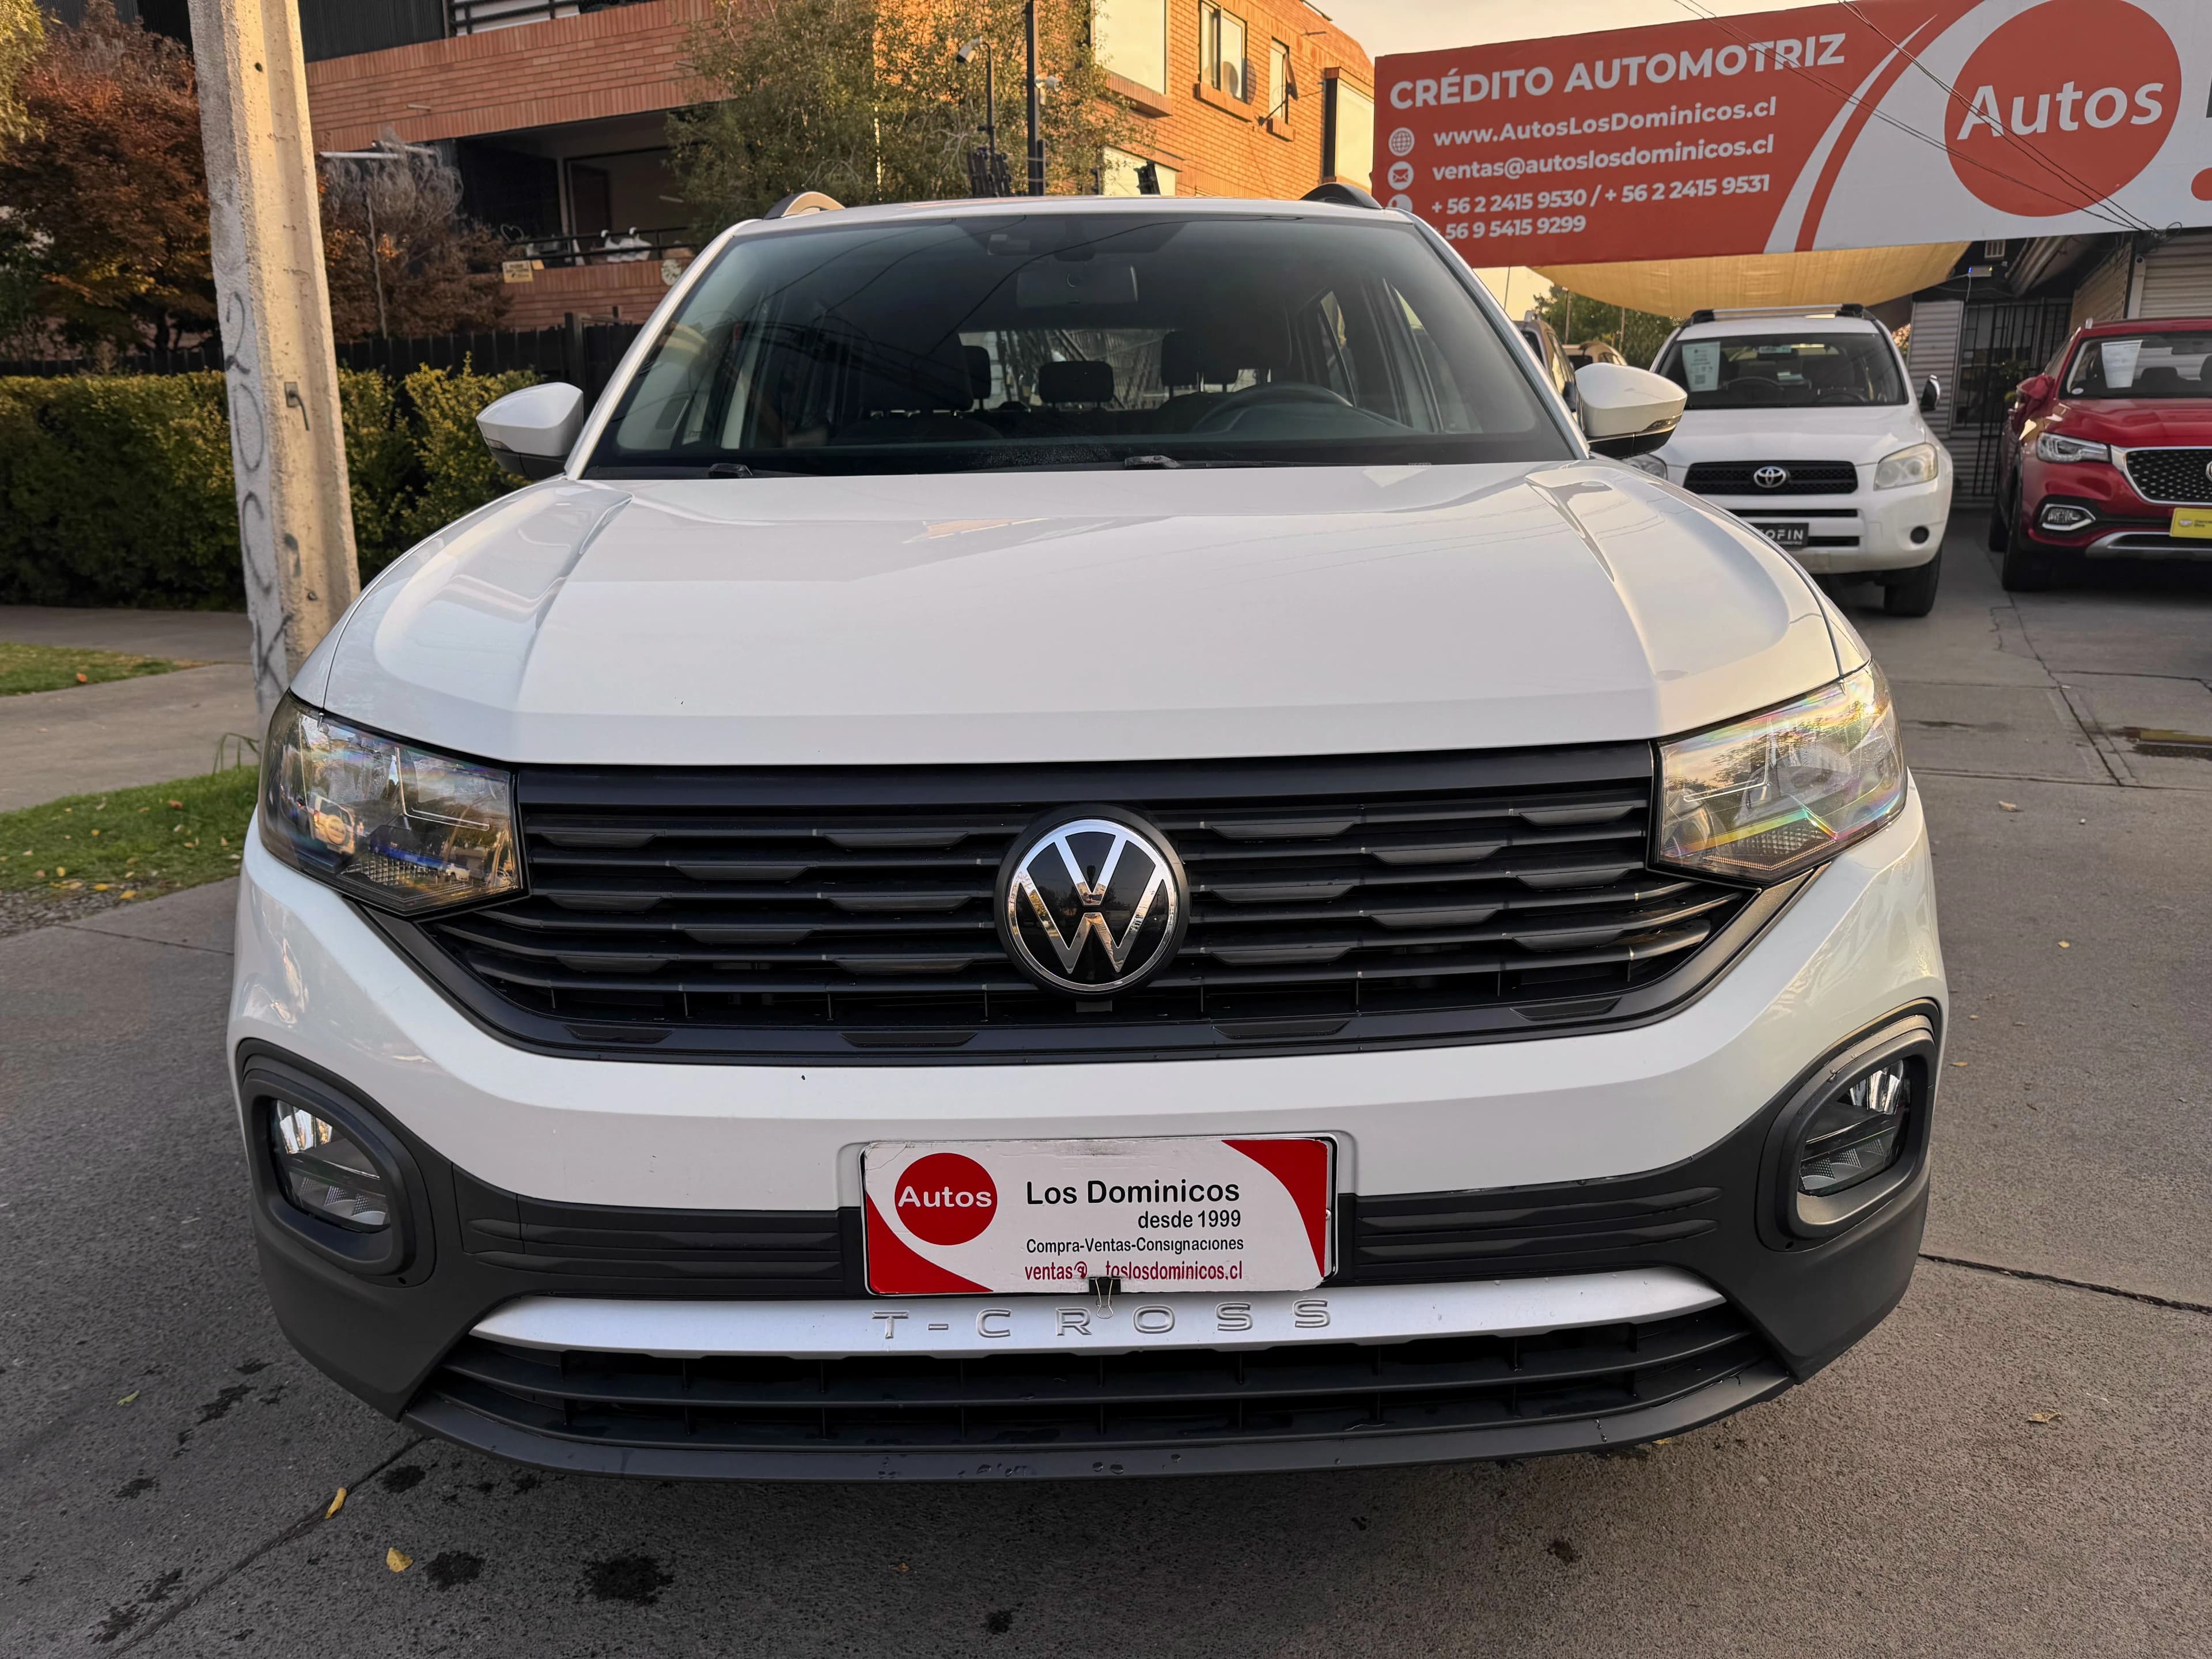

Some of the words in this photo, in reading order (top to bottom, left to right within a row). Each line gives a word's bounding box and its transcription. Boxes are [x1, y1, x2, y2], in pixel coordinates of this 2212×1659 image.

[1389, 66, 1554, 109] CRÉDITO
[1564, 33, 1846, 93] AUTOMOTRIZ
[1433, 96, 1777, 146] www.AutosLosDominicos.cl
[1957, 81, 2164, 140] Autos
[1432, 134, 1774, 180] ventas@autoslosdominicos.cl
[1431, 201, 1442, 213] +
[1446, 197, 1471, 214] 56
[1474, 196, 1486, 213] 2
[1490, 193, 1533, 211] 2415
[1537, 188, 1587, 209] 9530
[1605, 189, 1616, 201] +
[1621, 184, 1648, 203] 56
[1652, 183, 1665, 200] 2
[1669, 178, 1717, 199] 2415
[1721, 173, 1770, 195] 9531
[1445, 222, 1469, 240] 56
[1472, 222, 1486, 238] 9
[1489, 218, 1533, 237] 5415
[1536, 215, 1586, 234] 9299
[1759, 529, 1804, 540] OFIN
[897, 1185, 993, 1209] Autos
[1027, 1181, 1078, 1205] Los
[1087, 1179, 1240, 1204] Dominicos
[1138, 1210, 1194, 1229] desde
[1198, 1210, 1241, 1228] 1999
[1026, 1237, 1244, 1255] Compra-Ventas-Consignaciones
[871, 1299, 1331, 1340] T-CROSS
